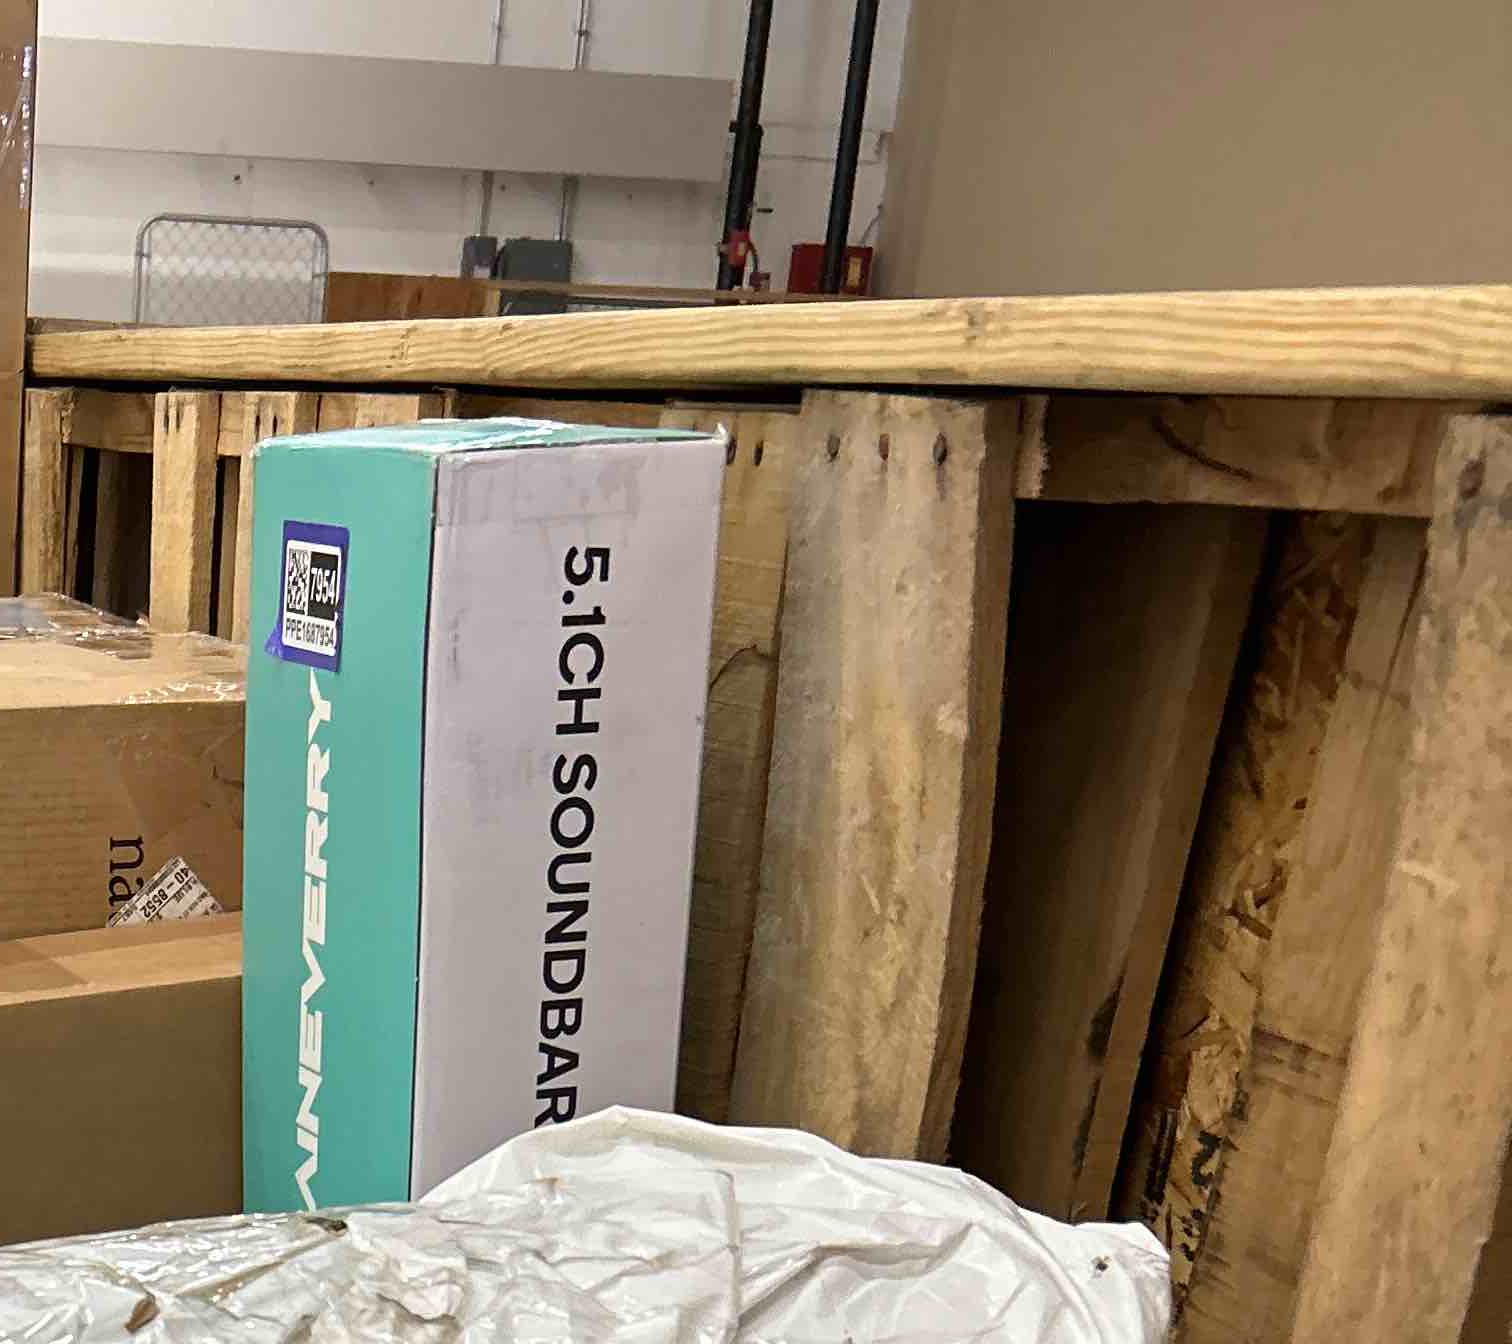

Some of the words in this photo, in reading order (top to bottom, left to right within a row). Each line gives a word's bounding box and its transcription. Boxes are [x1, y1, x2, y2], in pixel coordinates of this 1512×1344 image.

[310, 567, 337, 605] 7954
[555, 546, 611, 735] 5.1CH
[140, 888, 169, 919] 8552
[534, 754, 597, 1129] SOUNDBAR
